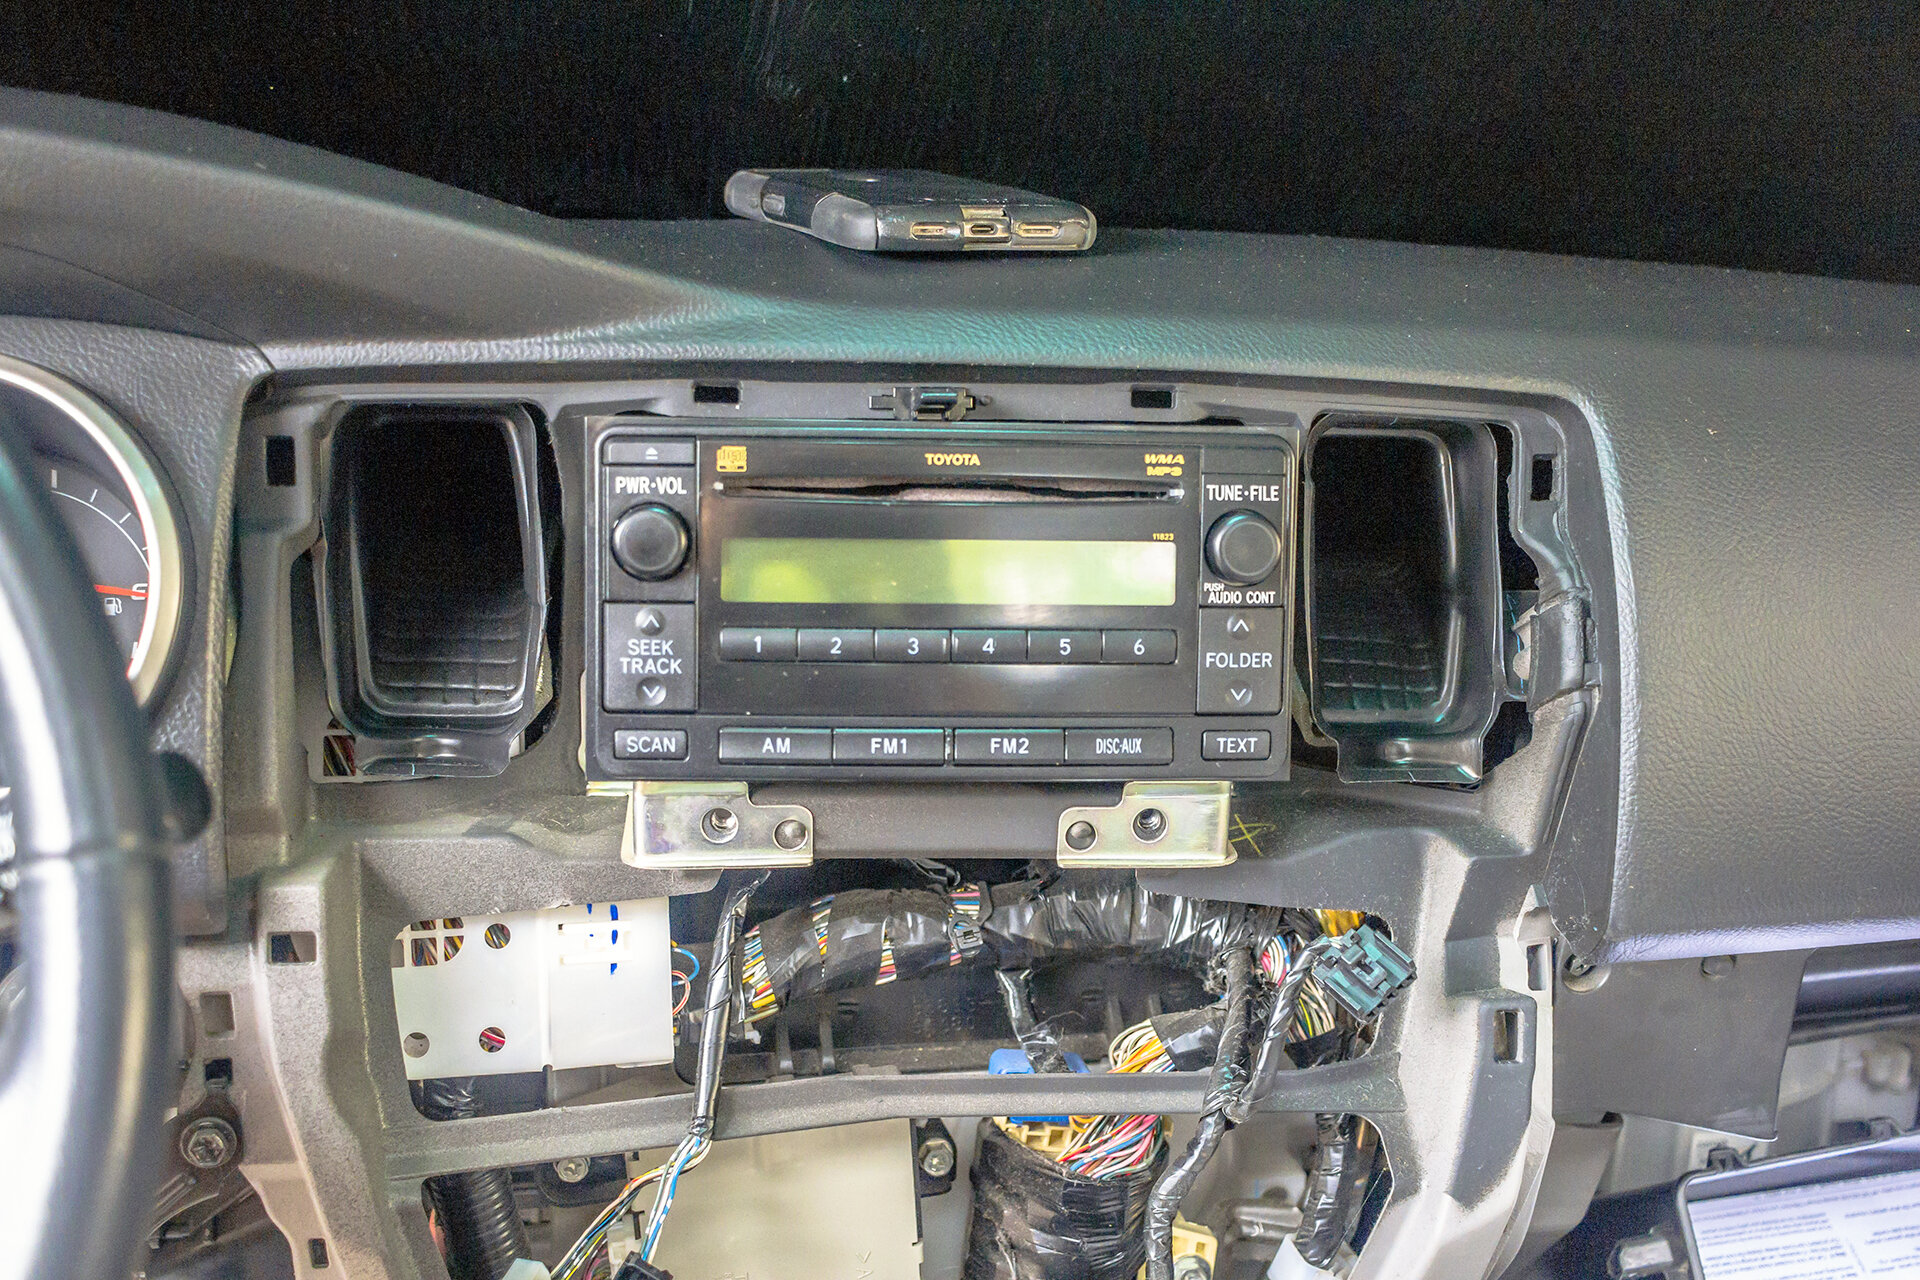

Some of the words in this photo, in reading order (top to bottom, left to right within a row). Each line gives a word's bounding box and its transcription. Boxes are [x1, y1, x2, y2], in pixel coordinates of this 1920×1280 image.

[924, 452, 981, 467] TOYOTA
[1144, 453, 1185, 465] WMA
[1146, 465, 1183, 477] MP3
[1152, 532, 1175, 541] 11823
[1203, 582, 1225, 592] PUSH
[1207, 591, 1243, 605] AUDIO
[1245, 591, 1276, 605] CONT
[626, 638, 675, 657] SEEK
[752, 635, 763, 654] 1
[829, 635, 843, 656] 2
[907, 636, 921, 656] 3
[982, 637, 997, 655] 4
[1059, 637, 1071, 656] 5
[1133, 638, 1145, 656] 6
[618, 656, 683, 675] TRACK
[1205, 652, 1273, 669] FOLDER
[625, 736, 677, 754] SCAN
[761, 737, 791, 754] AM
[870, 737, 907, 755] FM1
[990, 737, 1030, 755] FM2
[1215, 737, 1259, 753] TEXT
